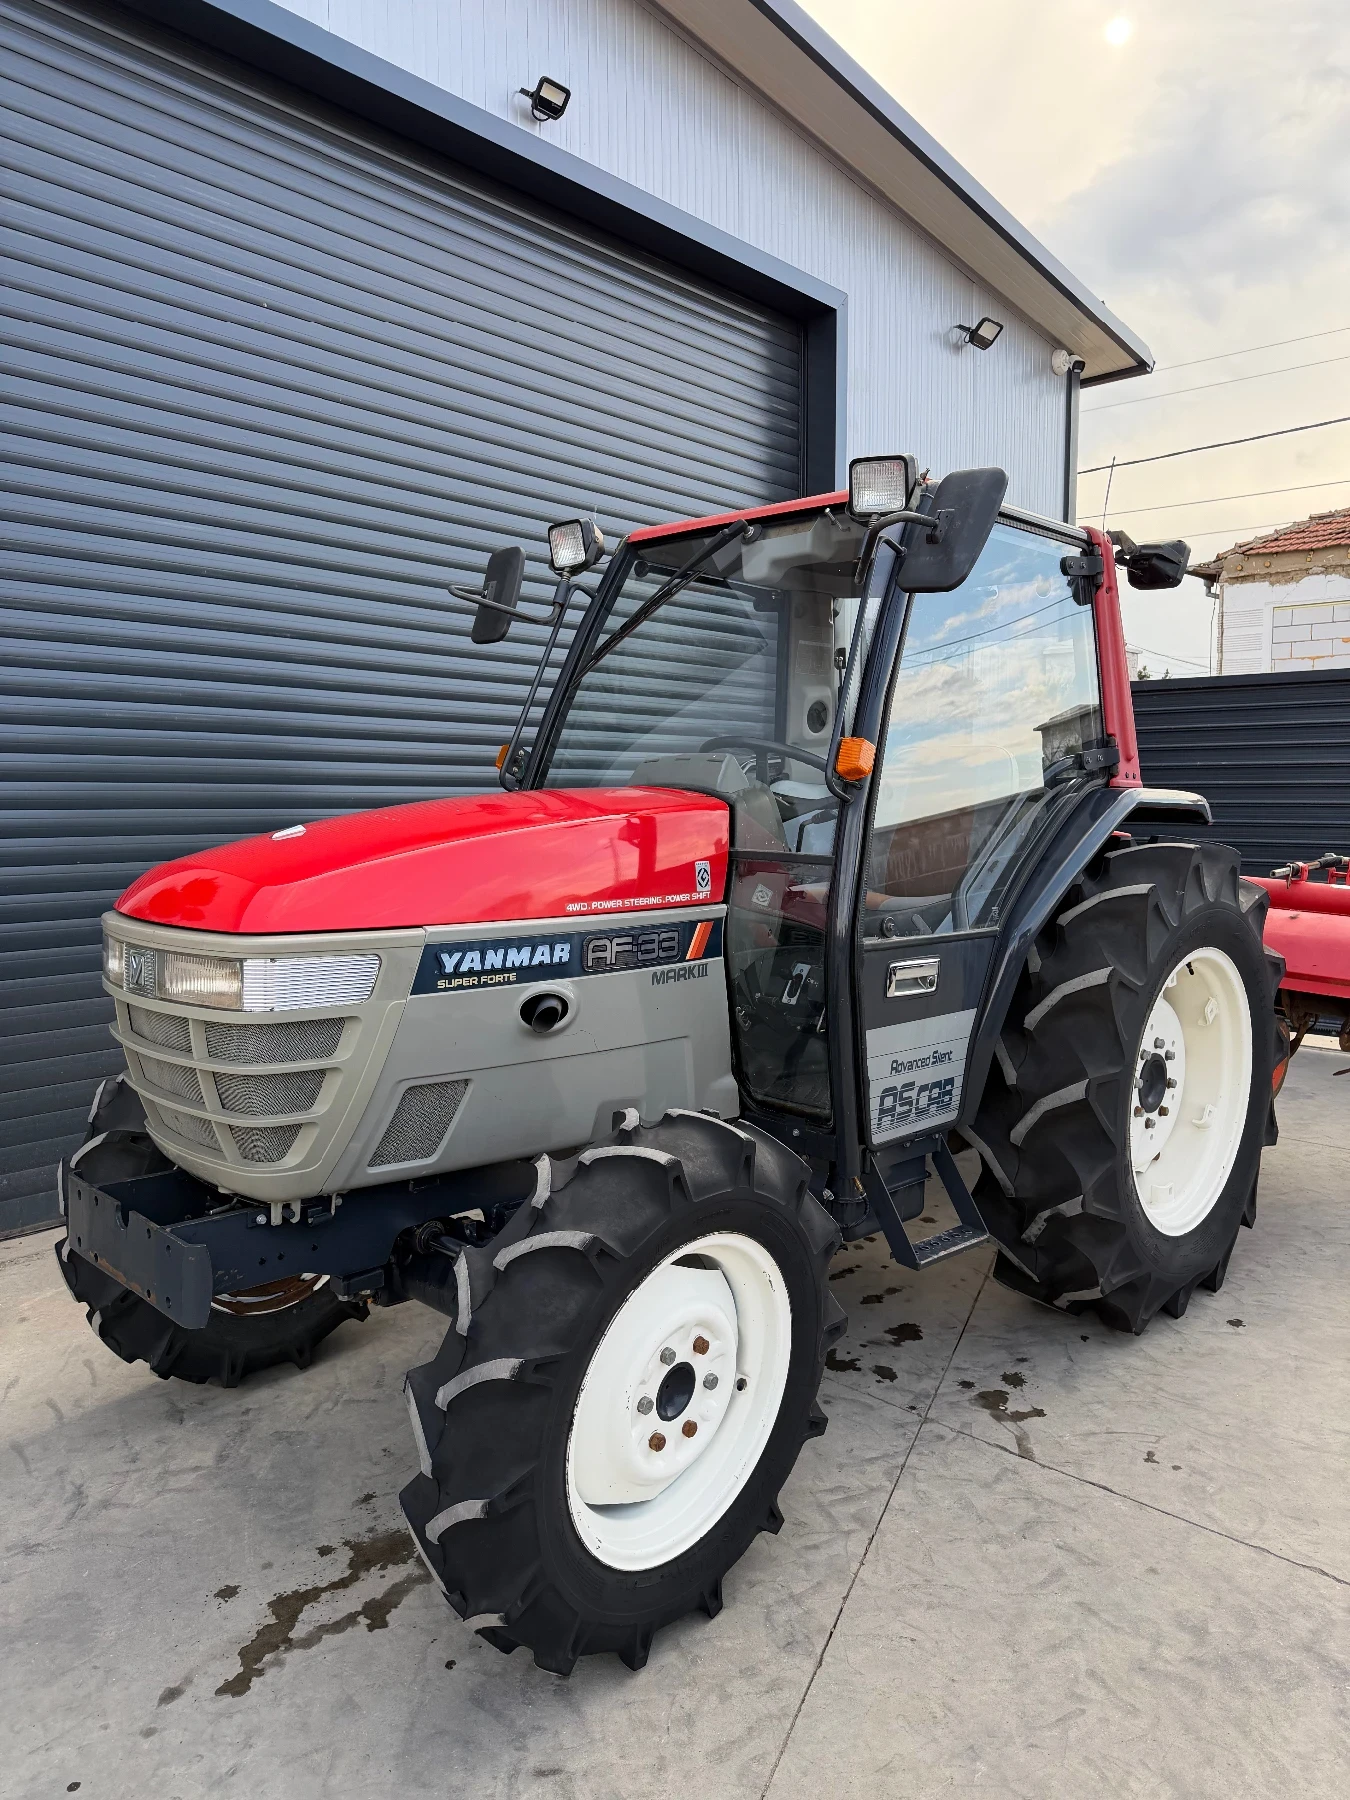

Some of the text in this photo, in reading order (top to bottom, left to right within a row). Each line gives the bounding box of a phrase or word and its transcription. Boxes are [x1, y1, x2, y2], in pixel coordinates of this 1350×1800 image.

[592, 900, 623, 910] POWER
[666, 894, 690, 903] POWER
[692, 891, 711, 901] SHIFT
[439, 942, 571, 974] YANMAR
[586, 929, 680, 968] AF-33
[437, 972, 517, 989] SUPER FORTE
[890, 1049, 953, 1076] Advanced Silent
